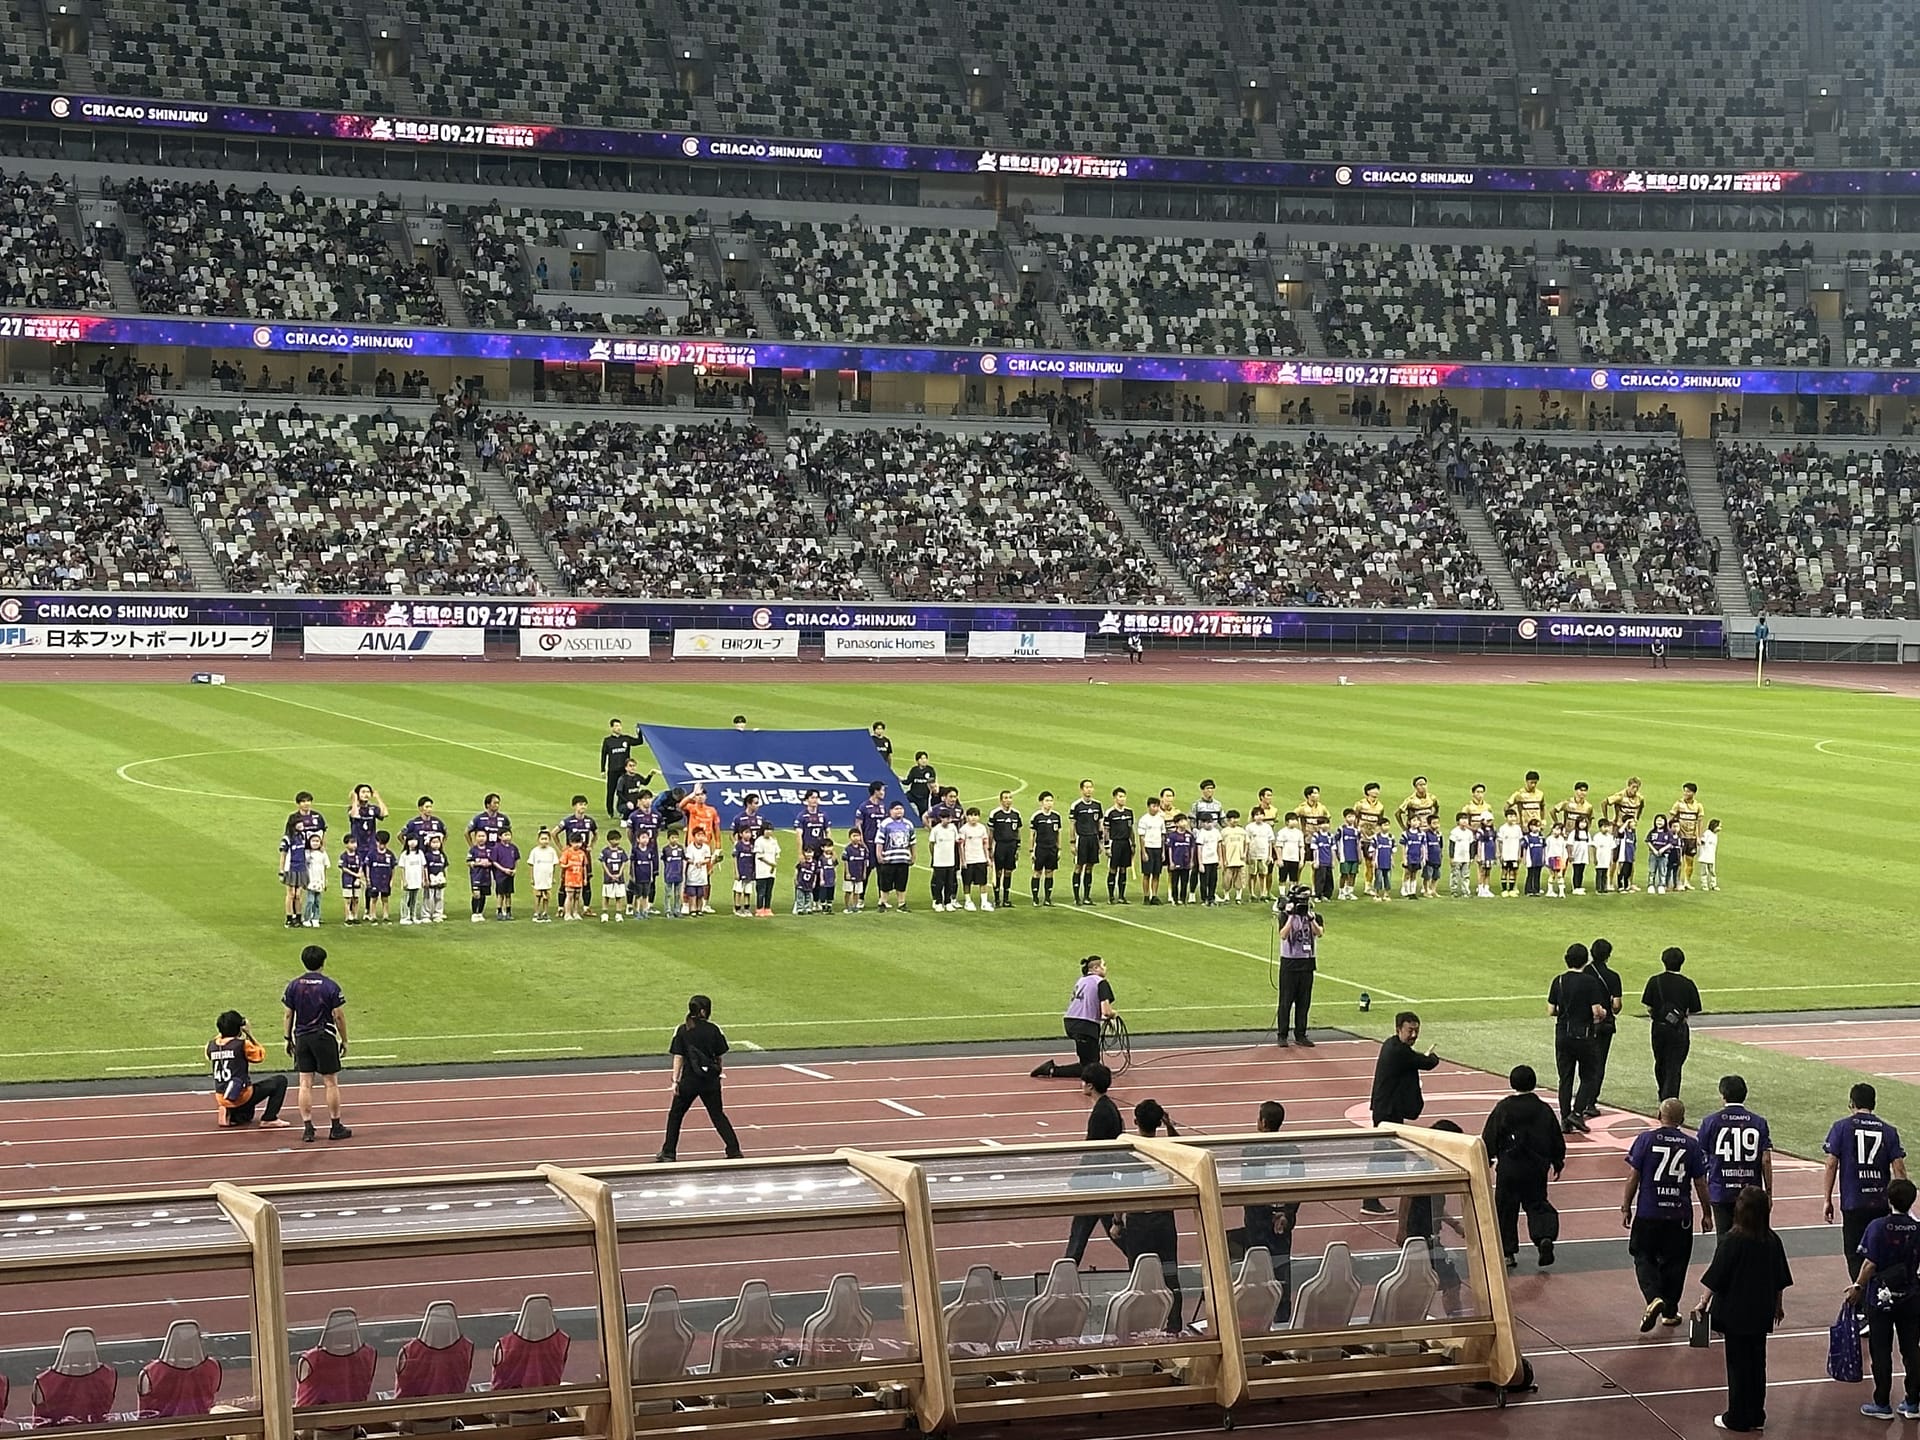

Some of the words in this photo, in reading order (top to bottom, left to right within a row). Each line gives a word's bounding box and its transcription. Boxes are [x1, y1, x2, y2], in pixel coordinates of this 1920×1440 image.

[82, 104, 144, 119] CRIACAO
[148, 109, 208, 122] SHINJUKU
[440, 125, 484, 144] 09.27
[710, 142, 766, 156] CRIACAO
[769, 146, 822, 159] SHINJUKU
[1041, 157, 1082, 174] 09.27
[1362, 171, 1418, 182] CRIACAO
[1420, 172, 1473, 184] SHINJUKU
[1690, 174, 1732, 191] 09.27
[285, 332, 348, 346] CRIACAO
[352, 336, 413, 348] SHINJUKU
[660, 344, 706, 362] 09.27
[1008, 359, 1065, 372] CRIACAO
[1068, 362, 1123, 373] SHINJUKU
[1345, 367, 1388, 384] 09.27
[1620, 374, 1679, 386] CRIACAO
[1682, 376, 1741, 388] SHINJUKU
[38, 604, 112, 618] CRIACAO
[117, 605, 189, 619] SHINJUKU
[467, 606, 519, 626] 09.27
[786, 612, 850, 626] CRIACAO
[854, 614, 916, 626] SHINJUKU
[1172, 615, 1220, 634] 09.27
[1550, 624, 1614, 636] CRIACAO
[1619, 626, 1682, 638] SHINJUKU
[47, 629, 270, 648] 日本フットボールリーグ
[358, 632, 407, 650] ANA
[837, 638, 893, 650] Panasonic
[896, 638, 935, 650] Homes
[684, 761, 856, 782] RESPECT
[1716, 1127, 1760, 1162] 419
[1854, 1129, 1883, 1165] 17
[1652, 1146, 1686, 1183] 74
